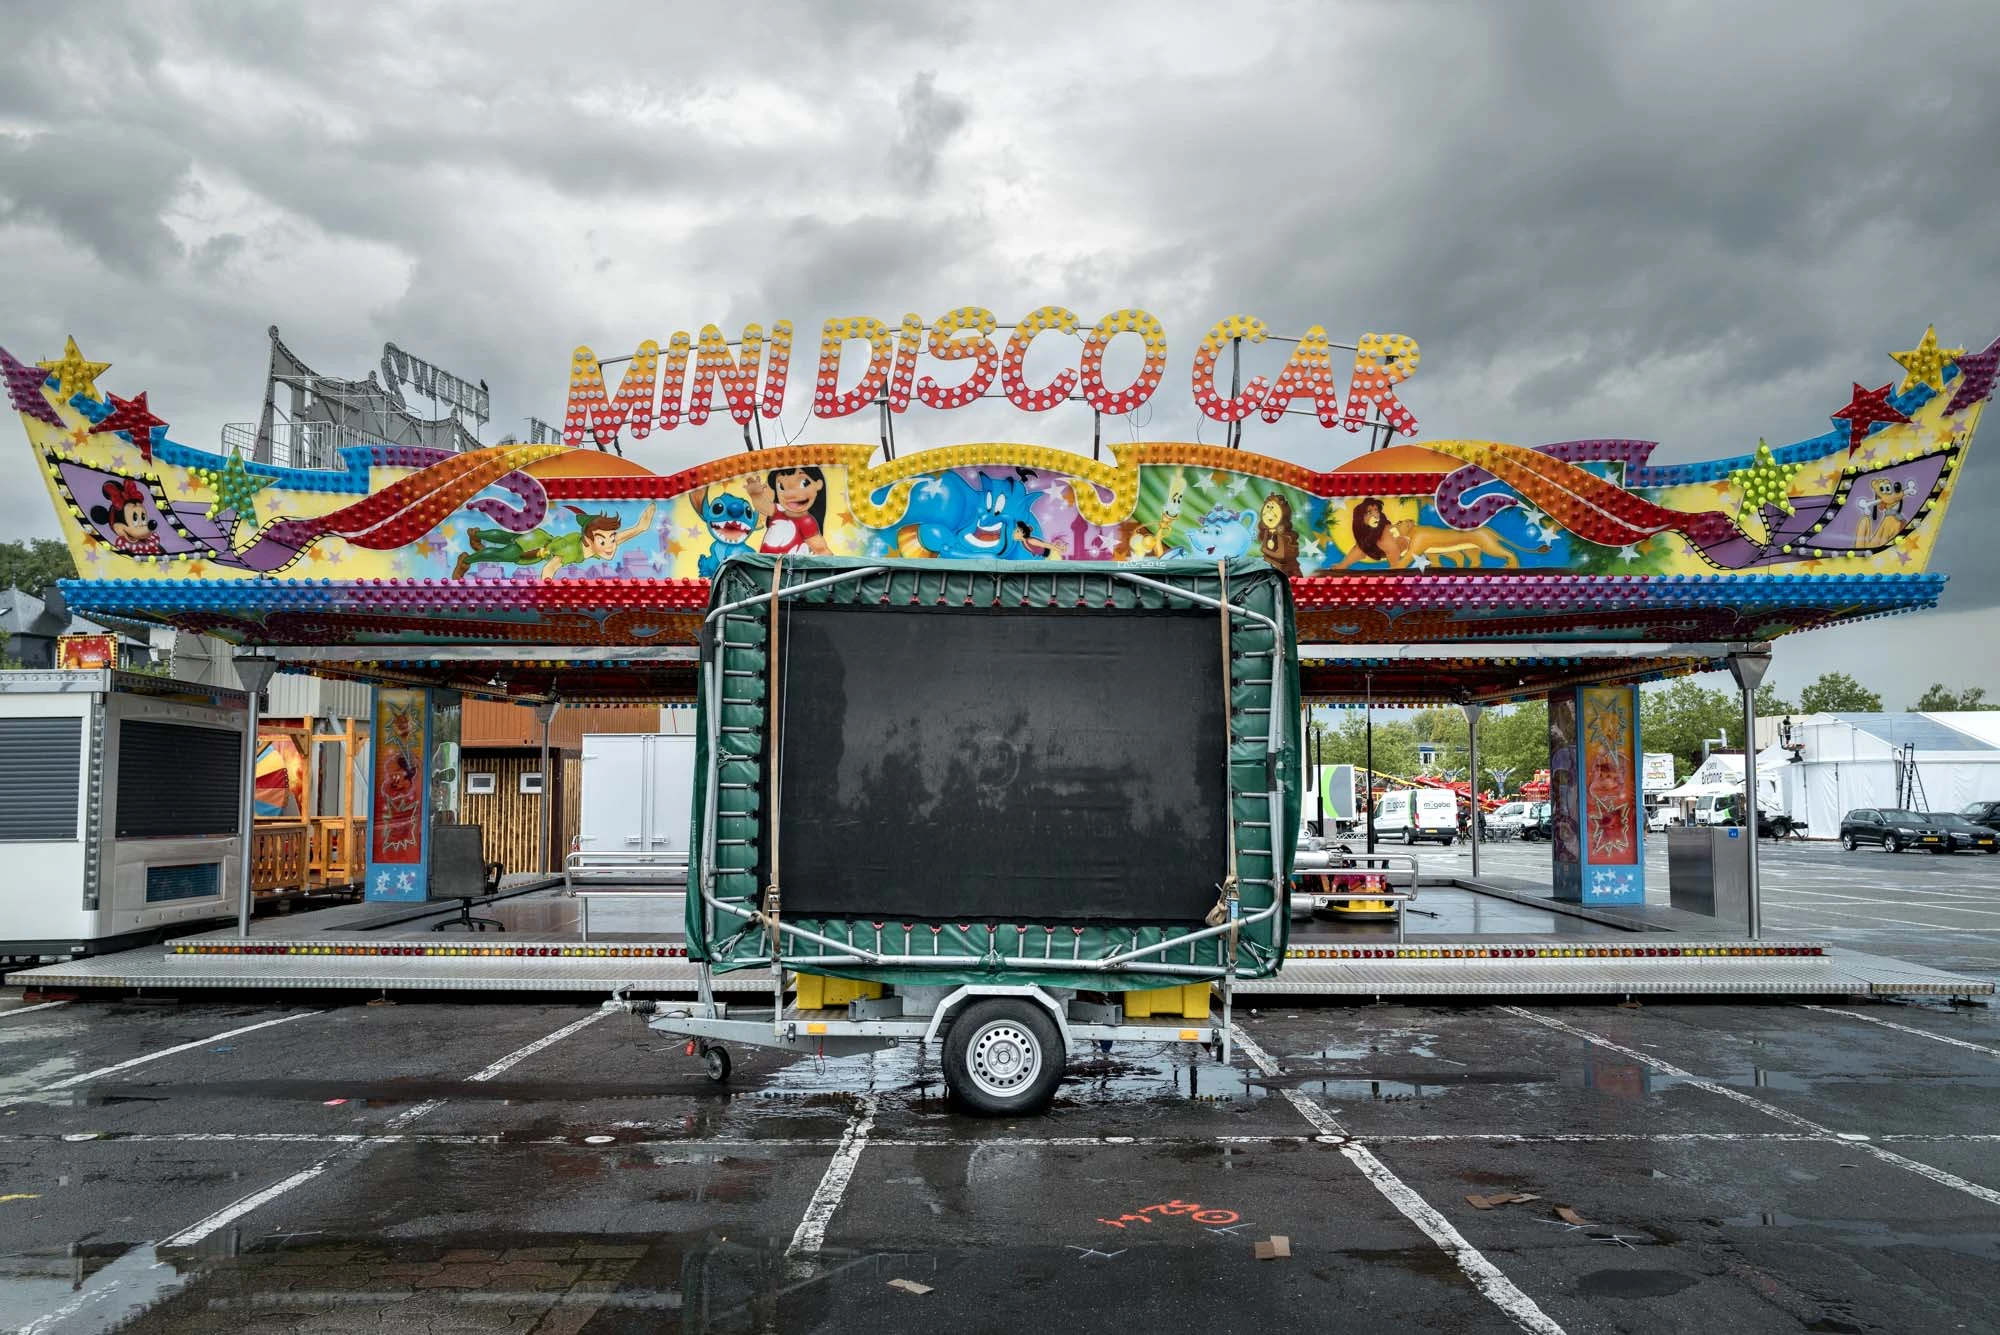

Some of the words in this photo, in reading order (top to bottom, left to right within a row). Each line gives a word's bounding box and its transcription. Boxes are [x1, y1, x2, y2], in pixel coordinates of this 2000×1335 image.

[564, 319, 793, 445] MINI
[814, 306, 1167, 419] DISCO
[1192, 313, 1420, 437] CAR
